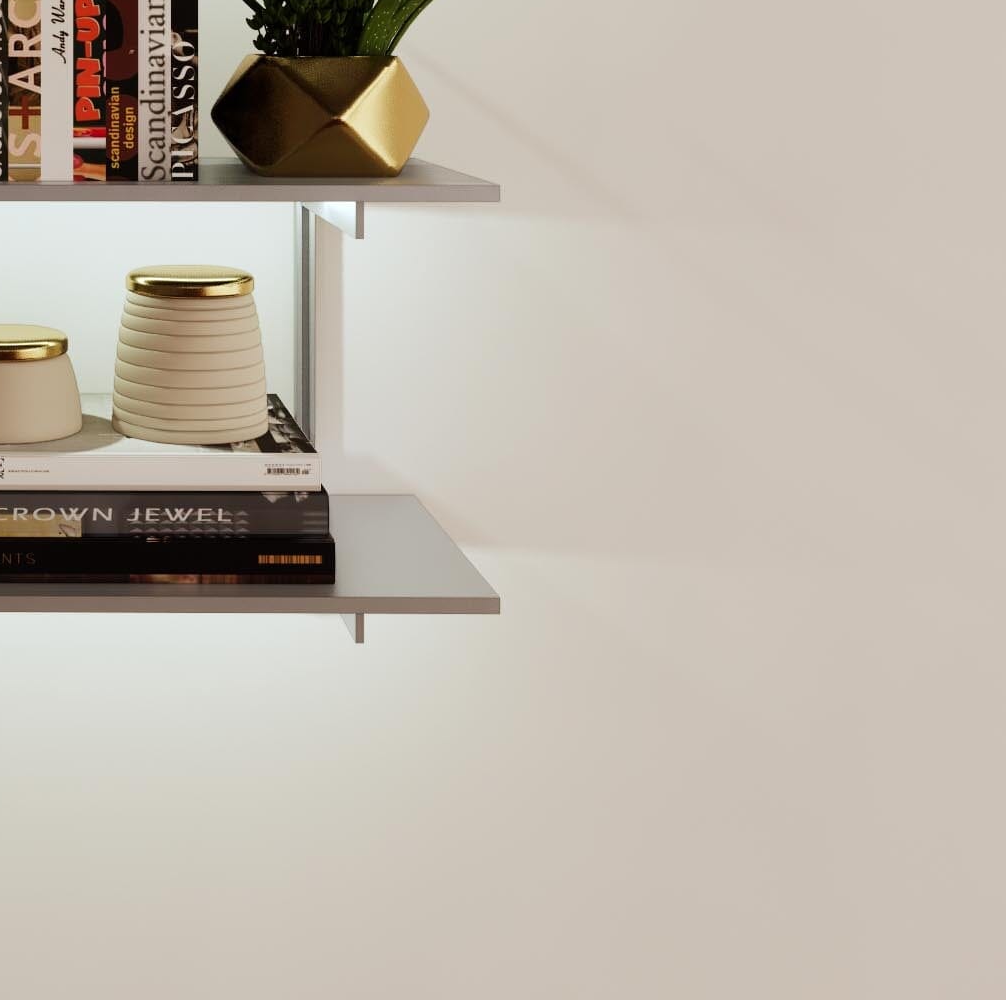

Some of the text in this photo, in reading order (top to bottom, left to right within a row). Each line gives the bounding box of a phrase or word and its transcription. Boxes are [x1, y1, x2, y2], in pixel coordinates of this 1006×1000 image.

[51, 30, 69, 64] Andy
[109, 86, 121, 168] scandinavian
[123, 105, 137, 149] design
[171, 37, 196, 180] PICASSO
[126, 507, 233, 523] JEWEL
